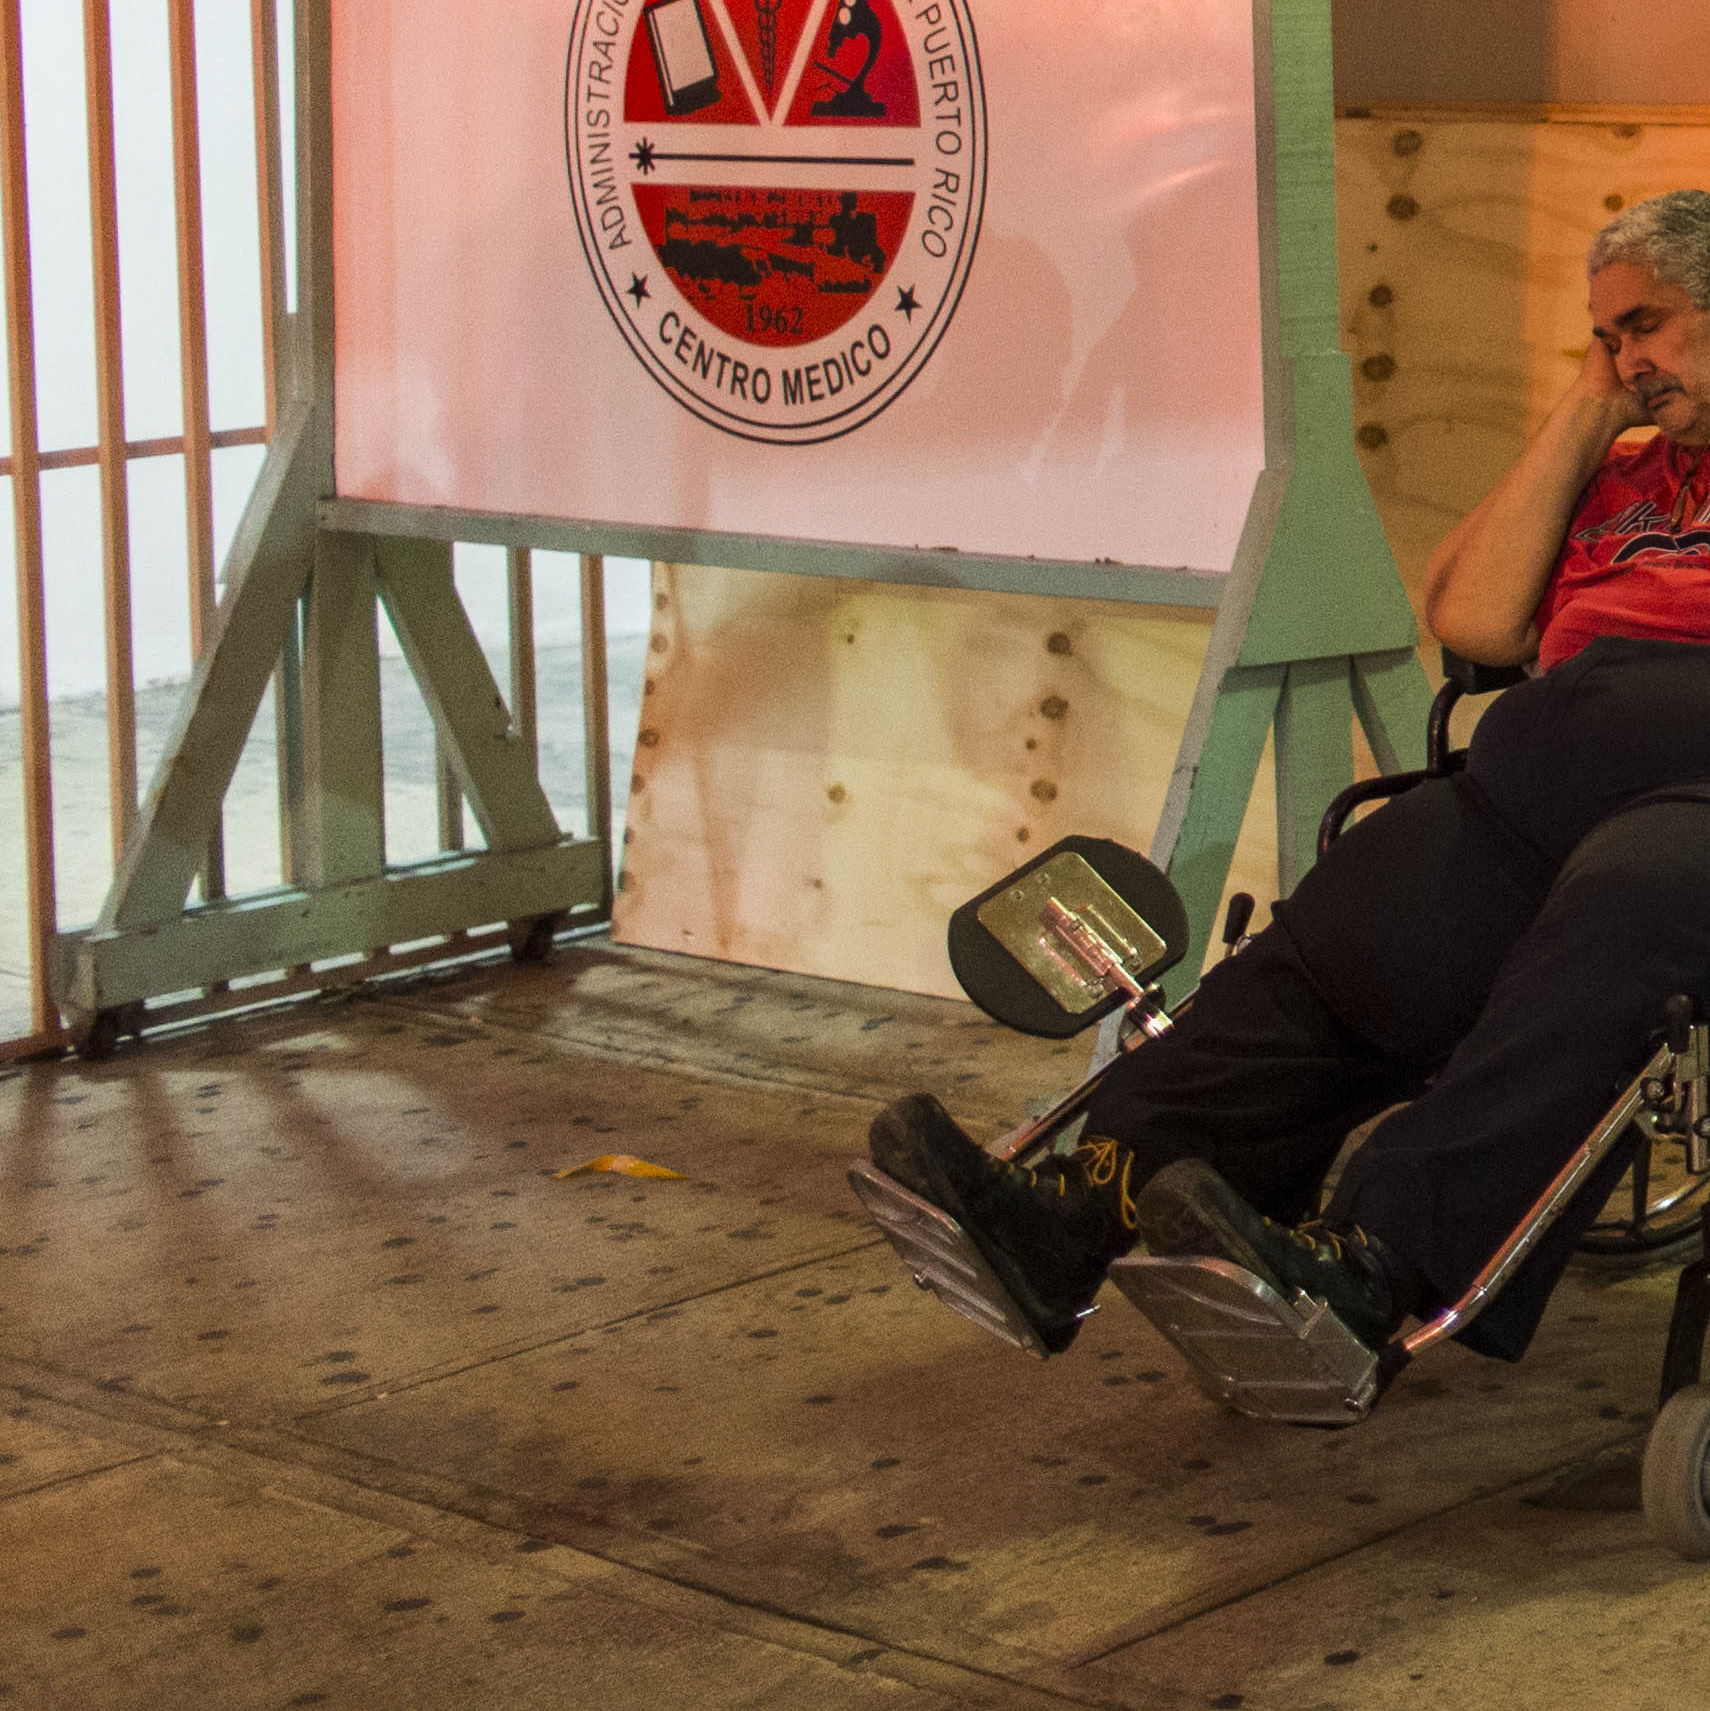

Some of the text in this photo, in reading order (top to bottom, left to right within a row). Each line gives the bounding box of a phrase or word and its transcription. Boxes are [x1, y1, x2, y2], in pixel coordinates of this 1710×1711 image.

[915, 3, 962, 156] PUERTO
[921, 167, 960, 258] RICO
[658, 311, 890, 406] CENTRO MEDICO
[744, 304, 805, 335] 1962
